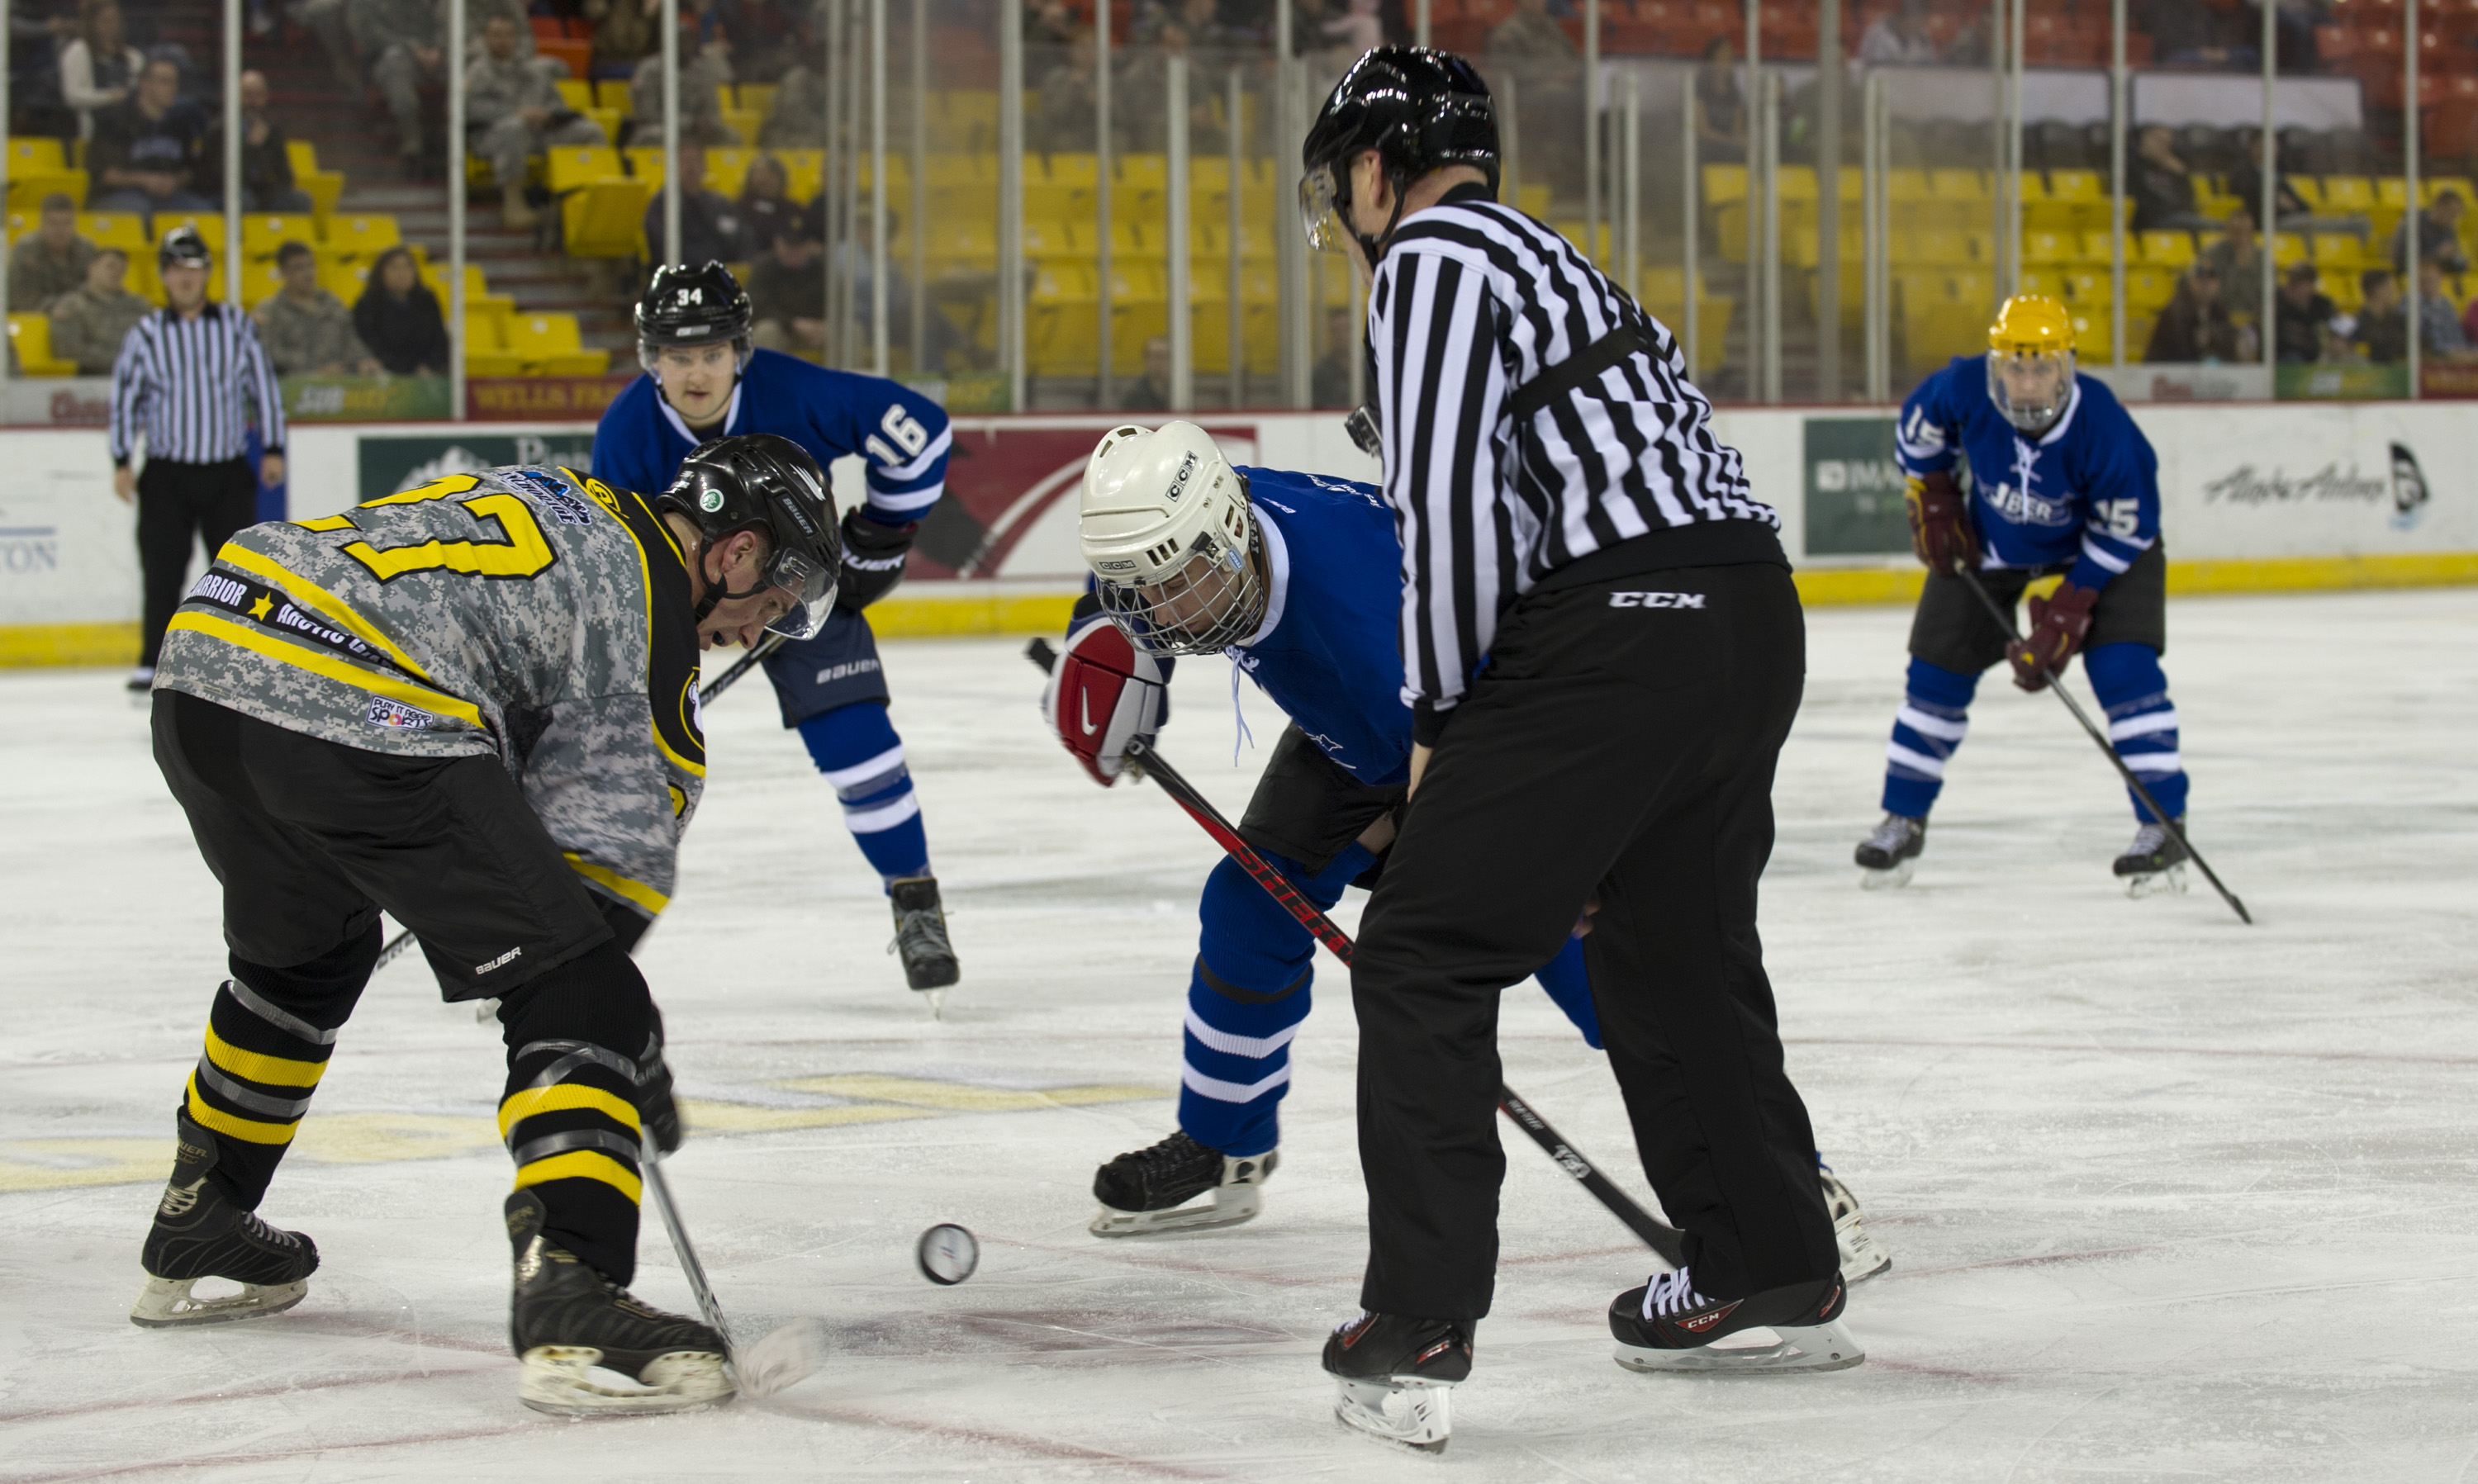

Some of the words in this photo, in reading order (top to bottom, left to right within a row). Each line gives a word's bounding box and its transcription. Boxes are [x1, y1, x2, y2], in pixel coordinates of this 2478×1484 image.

[677, 287, 702, 306] 34
[865, 403, 928, 467] 16
[1167, 453, 1197, 500] CCM
[783, 497, 814, 534] BAUER
[1099, 561, 1136, 570] CCM
[1608, 591, 1707, 609] CCM
[816, 659, 881, 685] BAUER
[374, 699, 395, 711] PLAY
[396, 705, 404, 714] IT
[475, 946, 522, 975] BAUER
[1688, 1312, 1720, 1329] CCM
